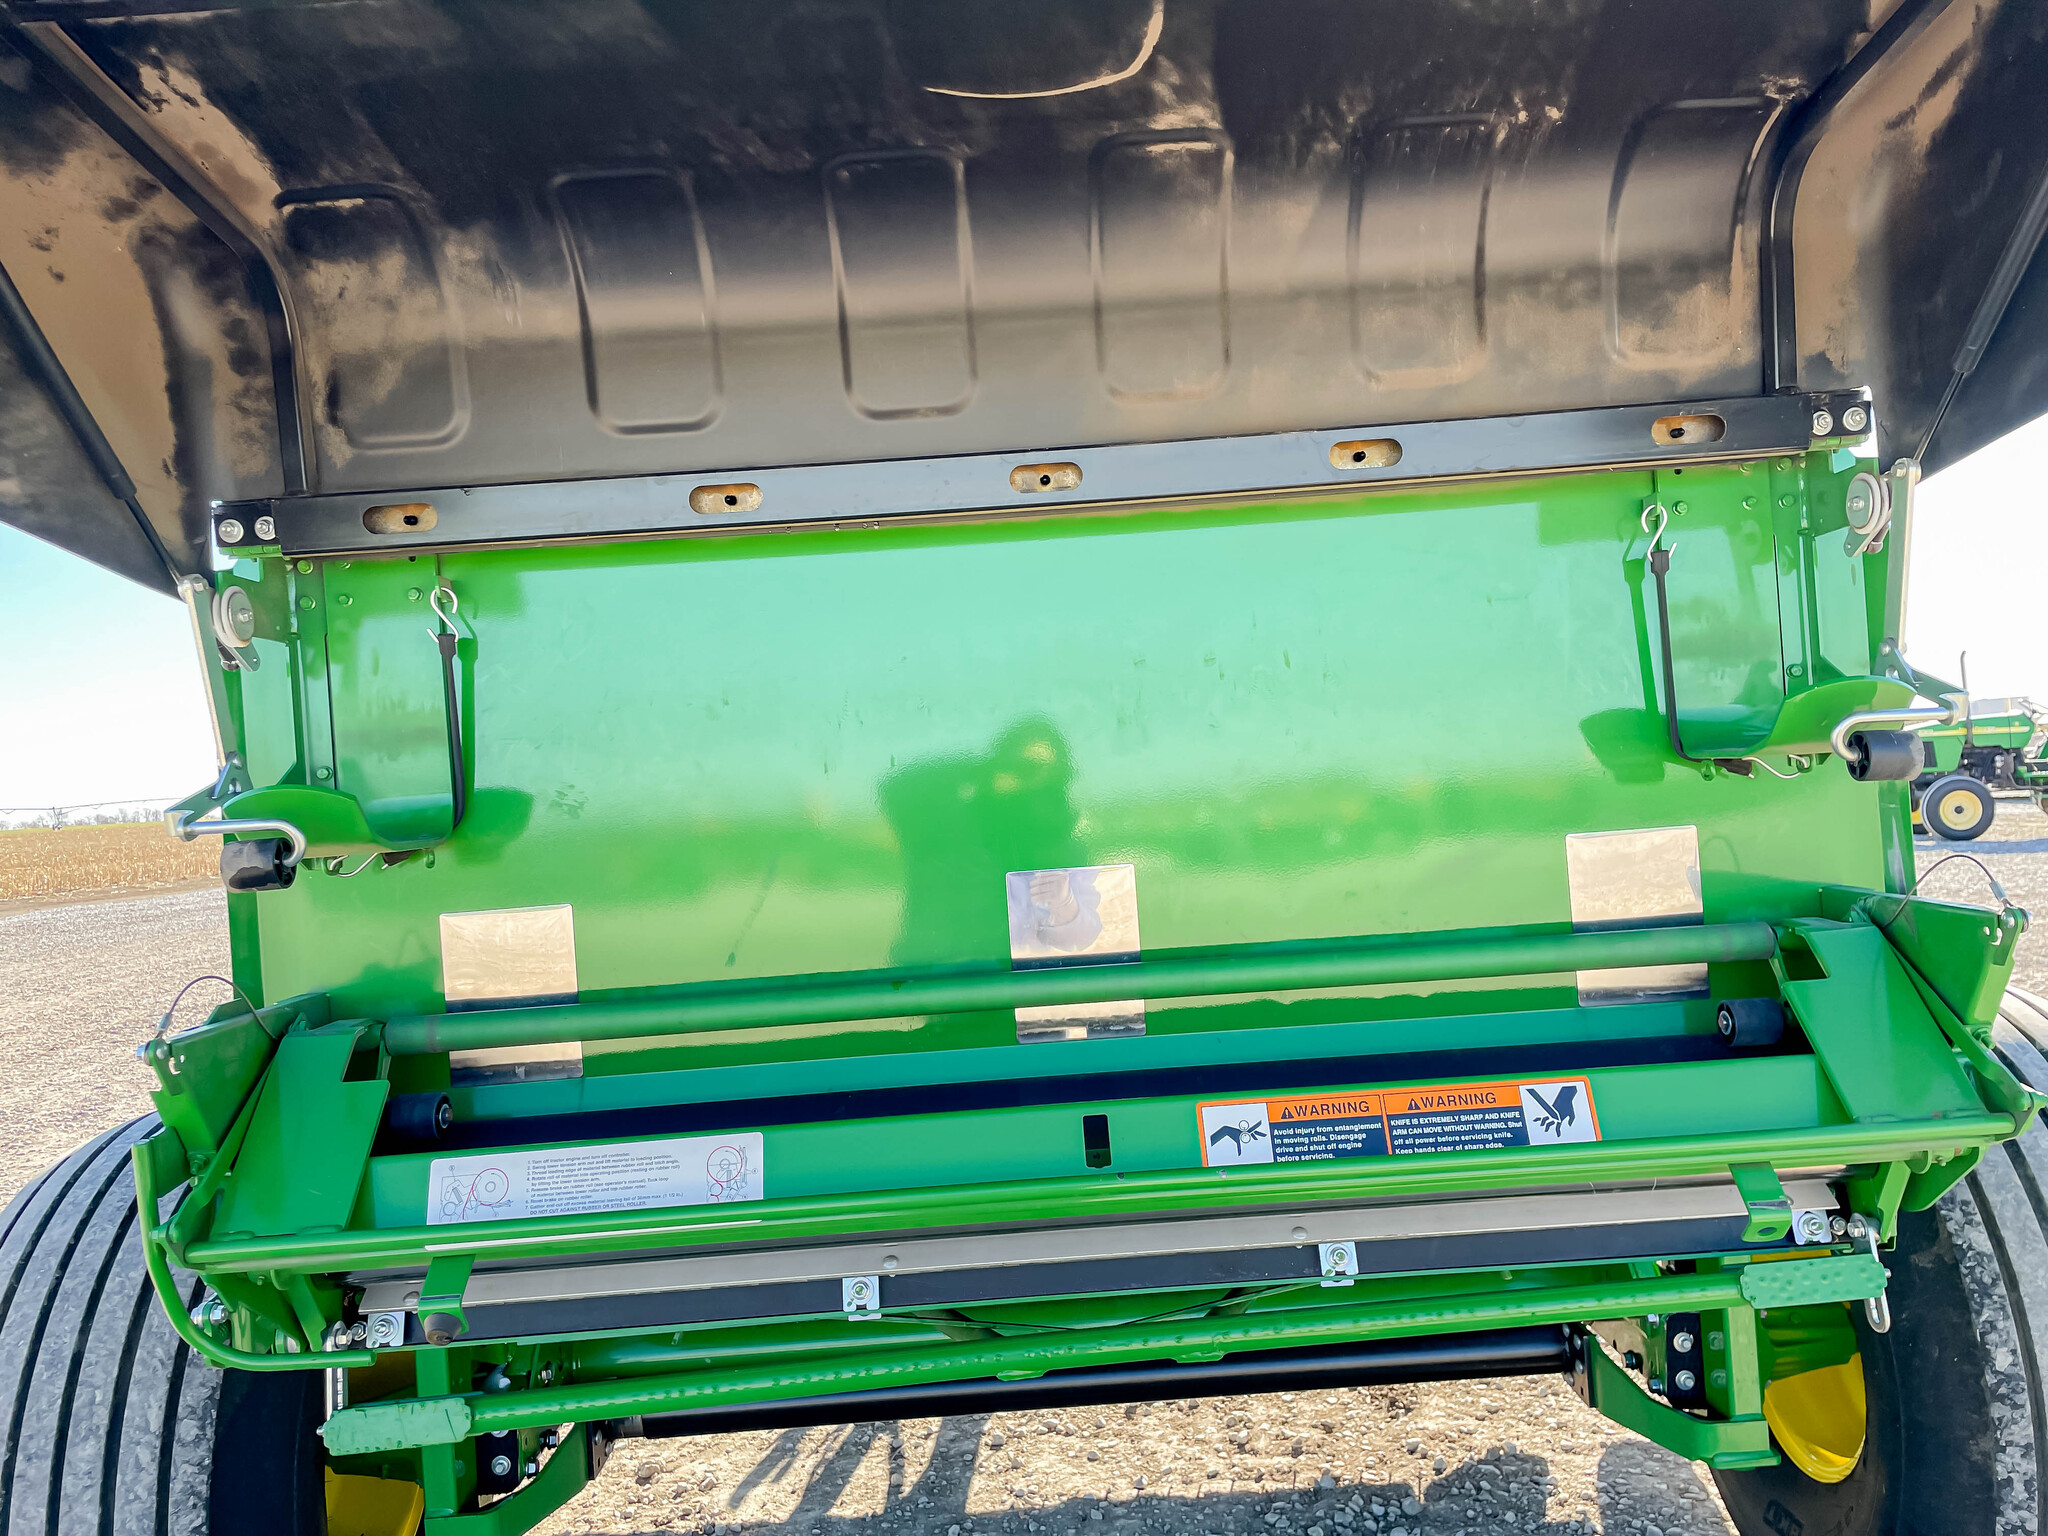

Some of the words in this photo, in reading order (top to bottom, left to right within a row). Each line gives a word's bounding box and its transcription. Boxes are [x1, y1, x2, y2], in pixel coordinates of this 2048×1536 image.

[1420, 1092, 1496, 1108] WARNING
[1294, 1100, 1370, 1118] WARNING
[1419, 1115, 1459, 1124] EXTREMELY
[1274, 1128, 1294, 1136] Avoid
[1294, 1126, 1315, 1136] injury
[1316, 1125, 1333, 1133] from
[1334, 1122, 1382, 1133] entanglement
[1443, 1124, 1473, 1132] WITHOUT
[1473, 1122, 1508, 1130] WARNING.
[1283, 1136, 1309, 1145] moving
[1330, 1132, 1367, 1142] Disengage
[1415, 1137, 1436, 1145] power
[1461, 1133, 1493, 1142] servicing
[1338, 1141, 1362, 1151] engine
[1276, 1154, 1300, 1162] before
